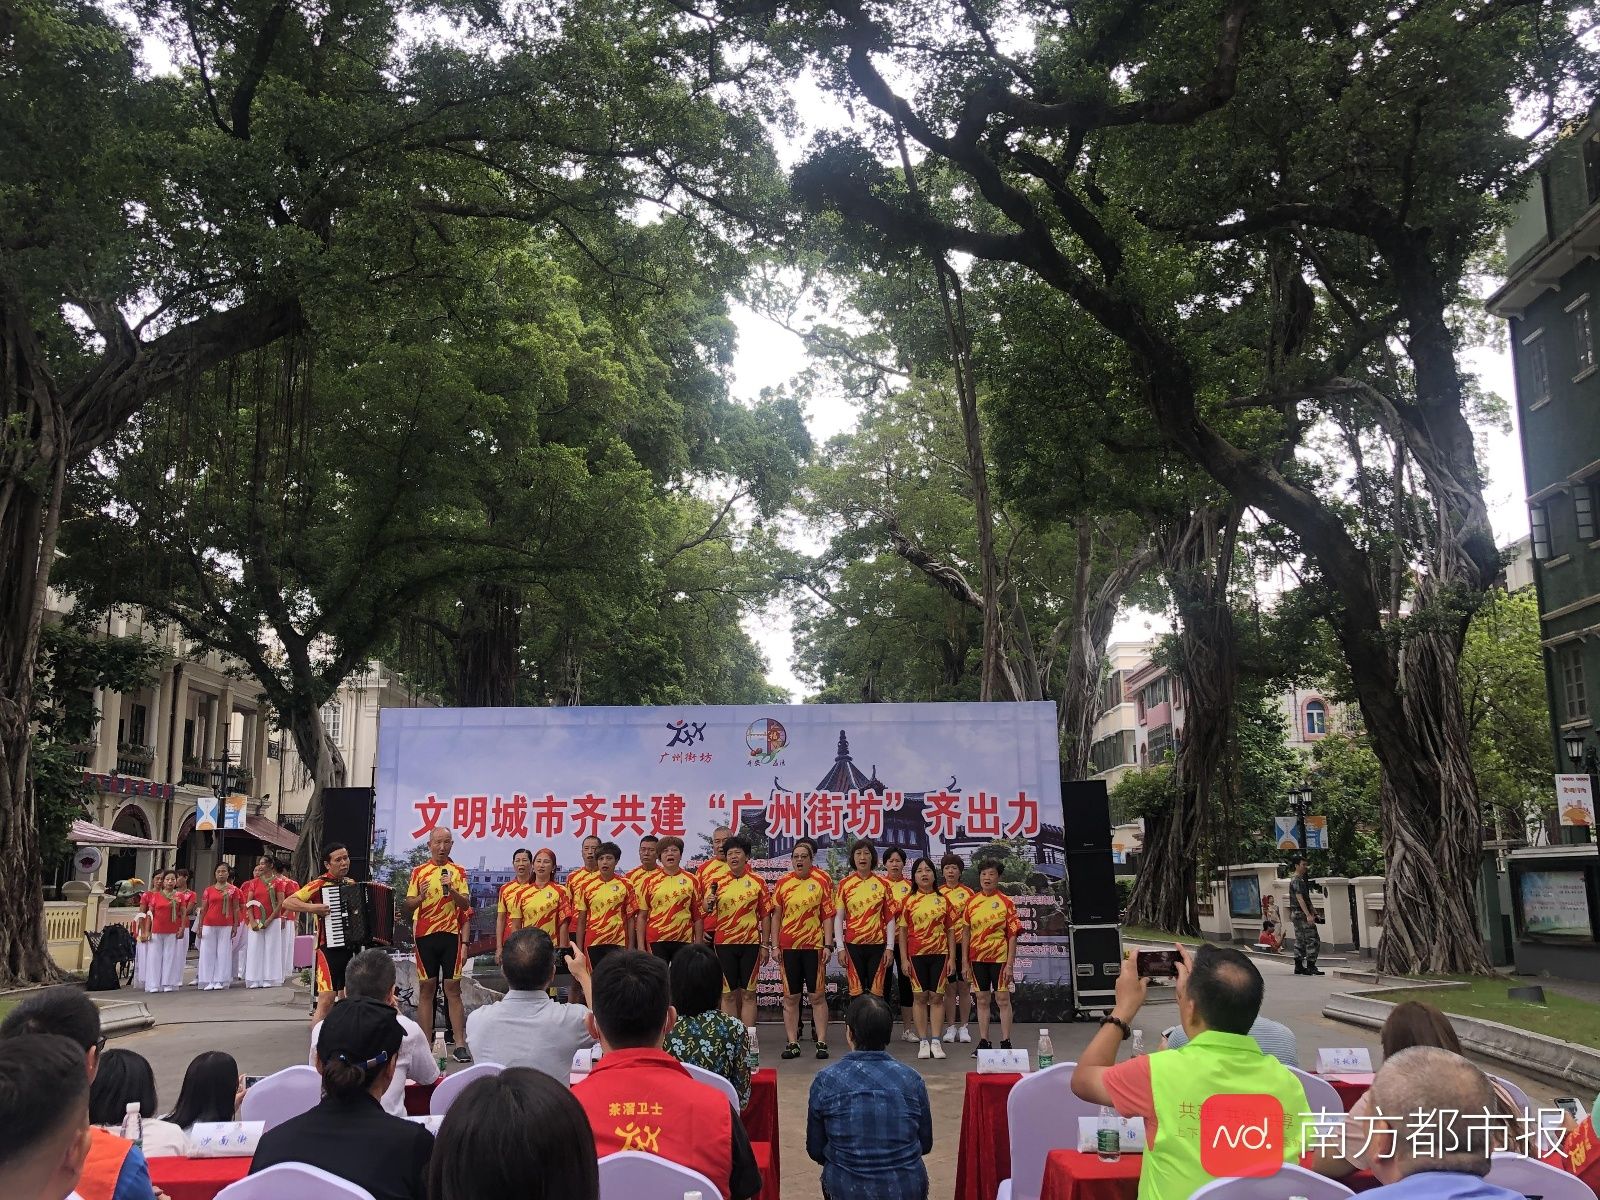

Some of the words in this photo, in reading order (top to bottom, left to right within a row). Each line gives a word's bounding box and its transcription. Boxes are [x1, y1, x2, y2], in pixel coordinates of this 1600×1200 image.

[659, 752, 713, 764] 广州街坊
[412, 794, 686, 839] 文明城市齐共建
[709, 792, 903, 836] “广州街坊”
[926, 792, 1038, 836] 齐出力
